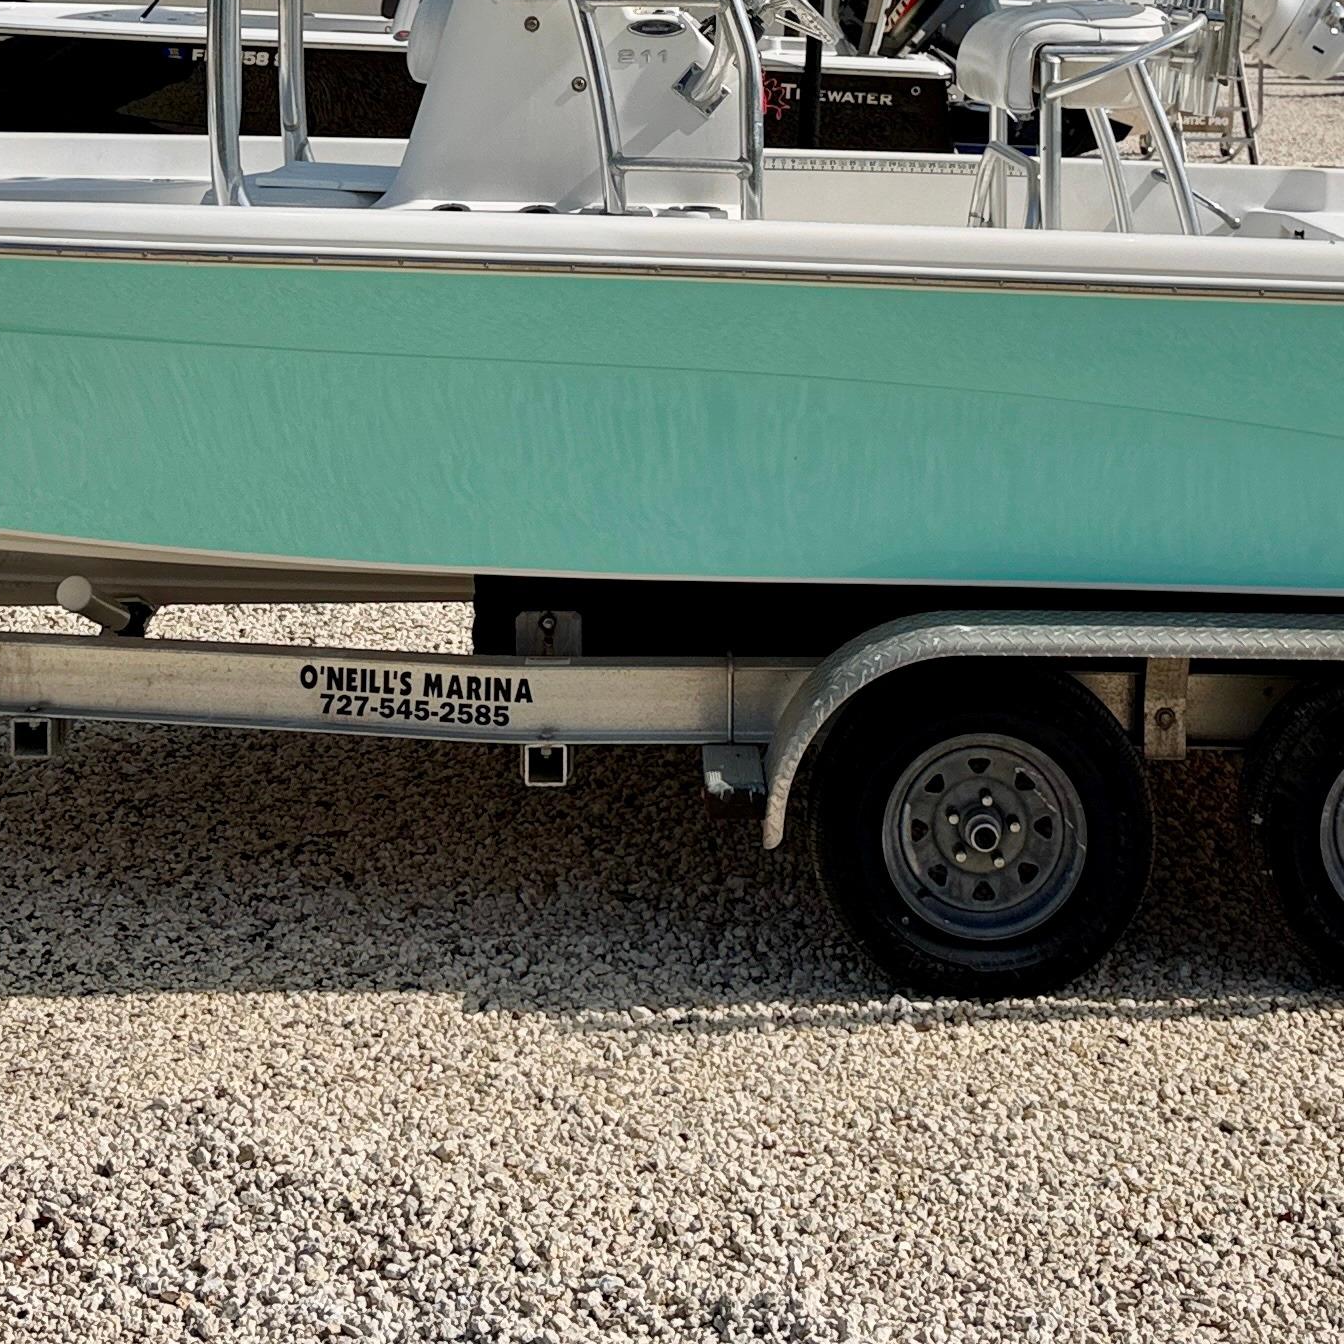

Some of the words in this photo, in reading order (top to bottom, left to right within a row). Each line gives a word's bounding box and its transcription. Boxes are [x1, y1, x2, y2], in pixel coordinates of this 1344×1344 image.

[617, 49, 669, 64] 211
[781, 82, 893, 106] TIEWATER
[1207, 116, 1229, 126] PRO
[299, 664, 413, 696] O'NEILL'S
[423, 672, 534, 704] MARINA
[319, 693, 510, 727] 727-545-2585
